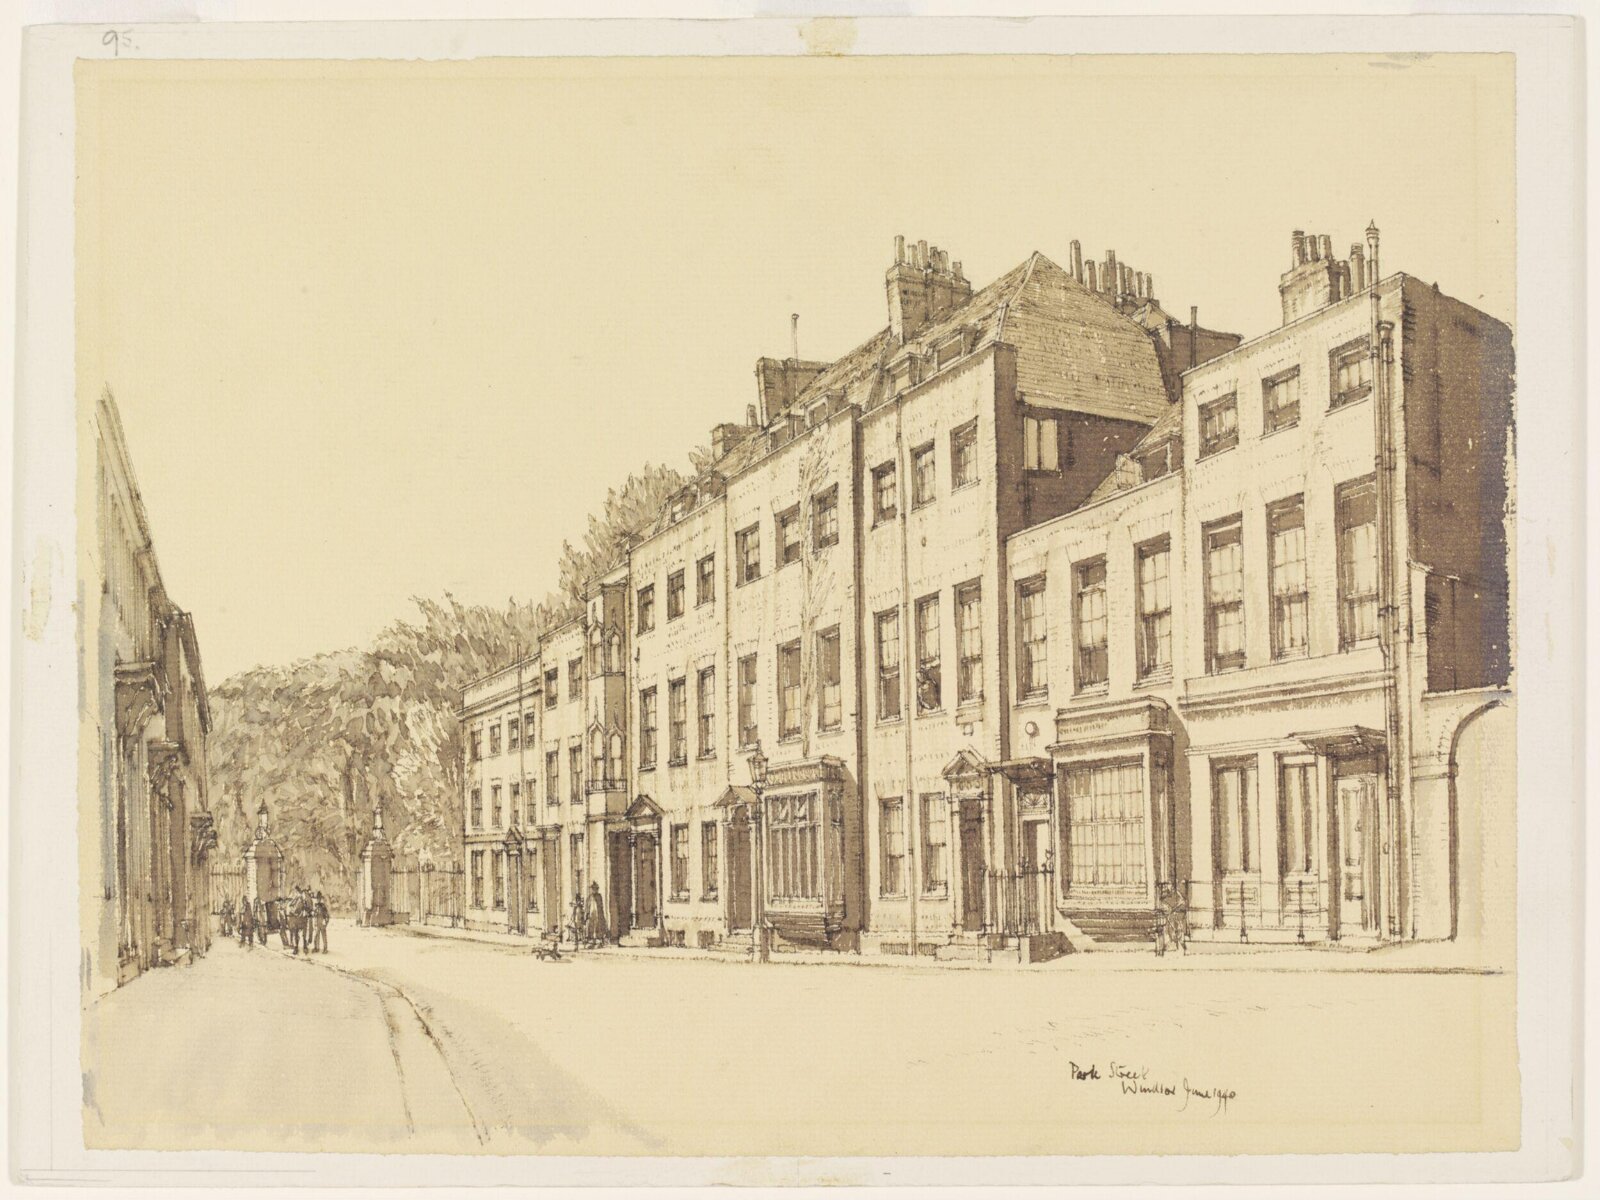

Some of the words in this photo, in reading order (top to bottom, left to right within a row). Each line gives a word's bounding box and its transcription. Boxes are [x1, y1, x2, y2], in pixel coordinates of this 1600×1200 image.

[1069, 1061, 1101, 1081] Park
[1108, 1061, 1150, 1080] Street
[1121, 1080, 1176, 1096] Windsor
